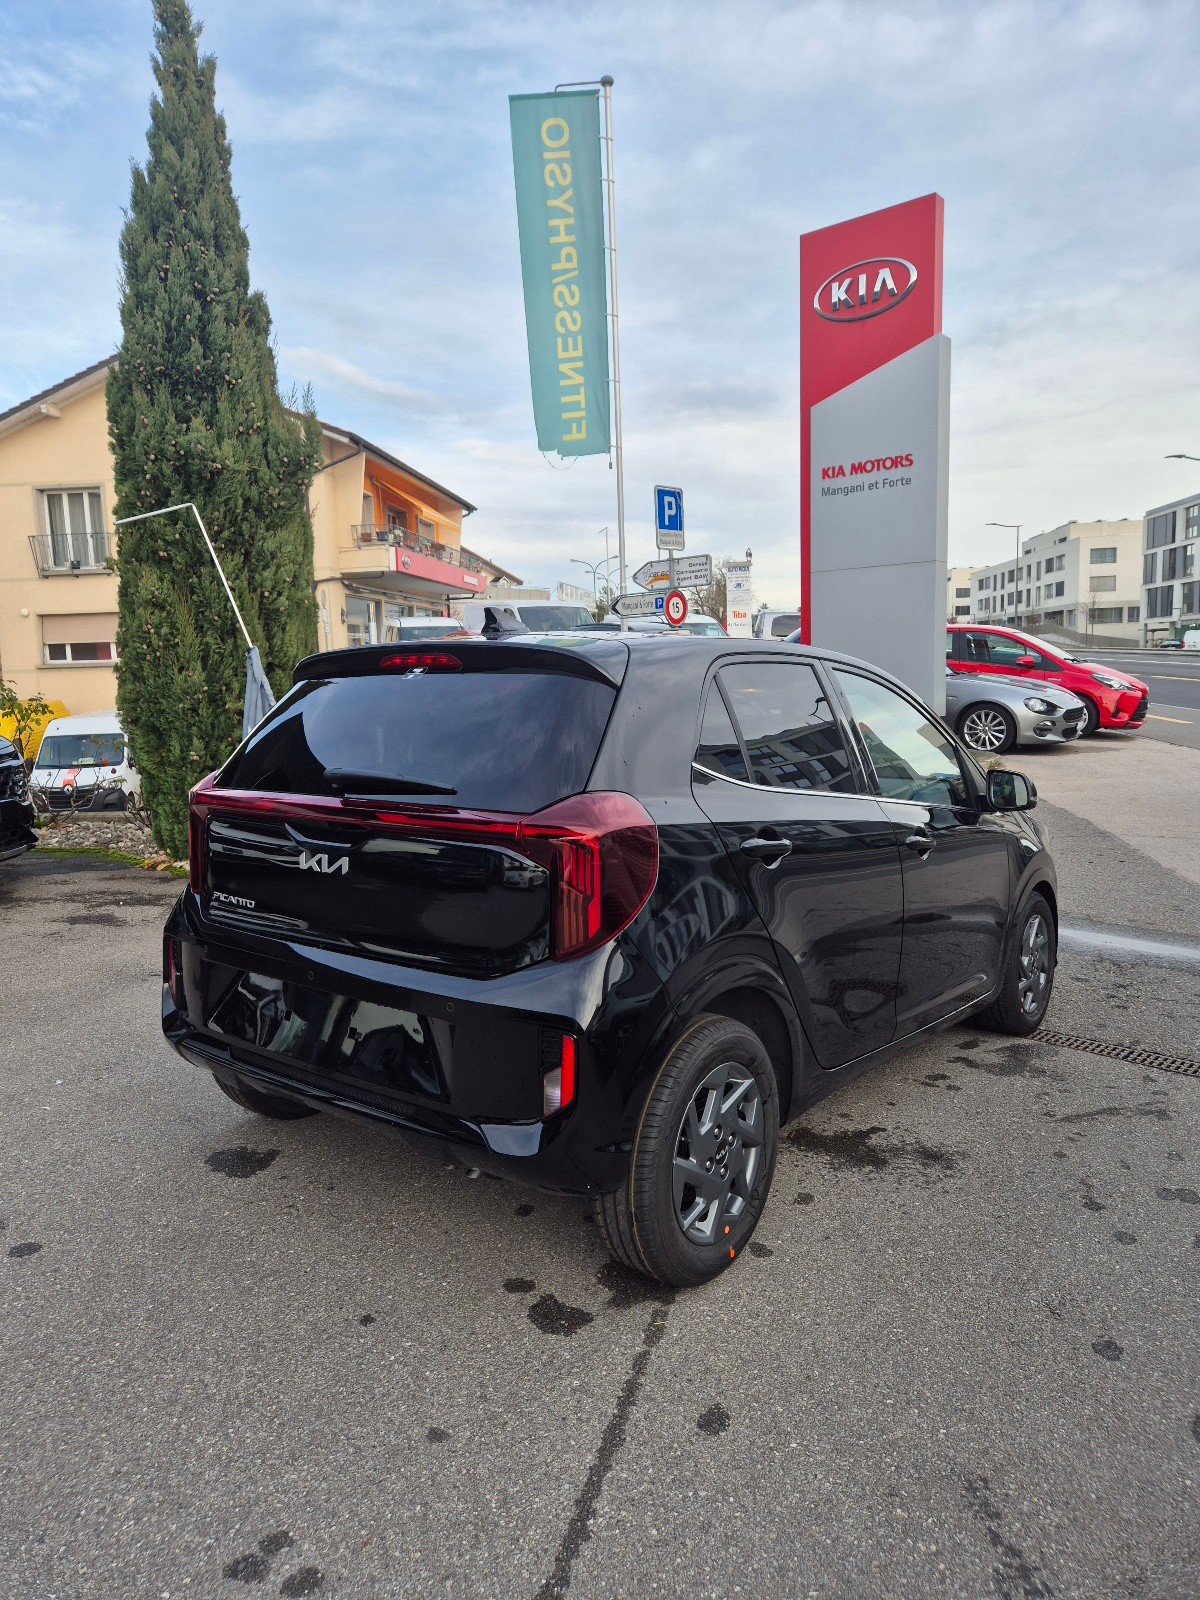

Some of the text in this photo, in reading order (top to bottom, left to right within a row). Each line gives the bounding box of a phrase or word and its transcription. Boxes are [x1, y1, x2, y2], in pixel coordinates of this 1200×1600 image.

[831, 267, 898, 312] KIA
[821, 453, 914, 480] KIA MOTORS
[821, 475, 912, 498] Mangani et Forte
[663, 495, 676, 526] P
[657, 598, 663, 607] P
[672, 602, 680, 613] 15
[732, 610, 747, 619] Tiba
[299, 851, 349, 875] KIA
[213, 891, 255, 908] PICANTO
